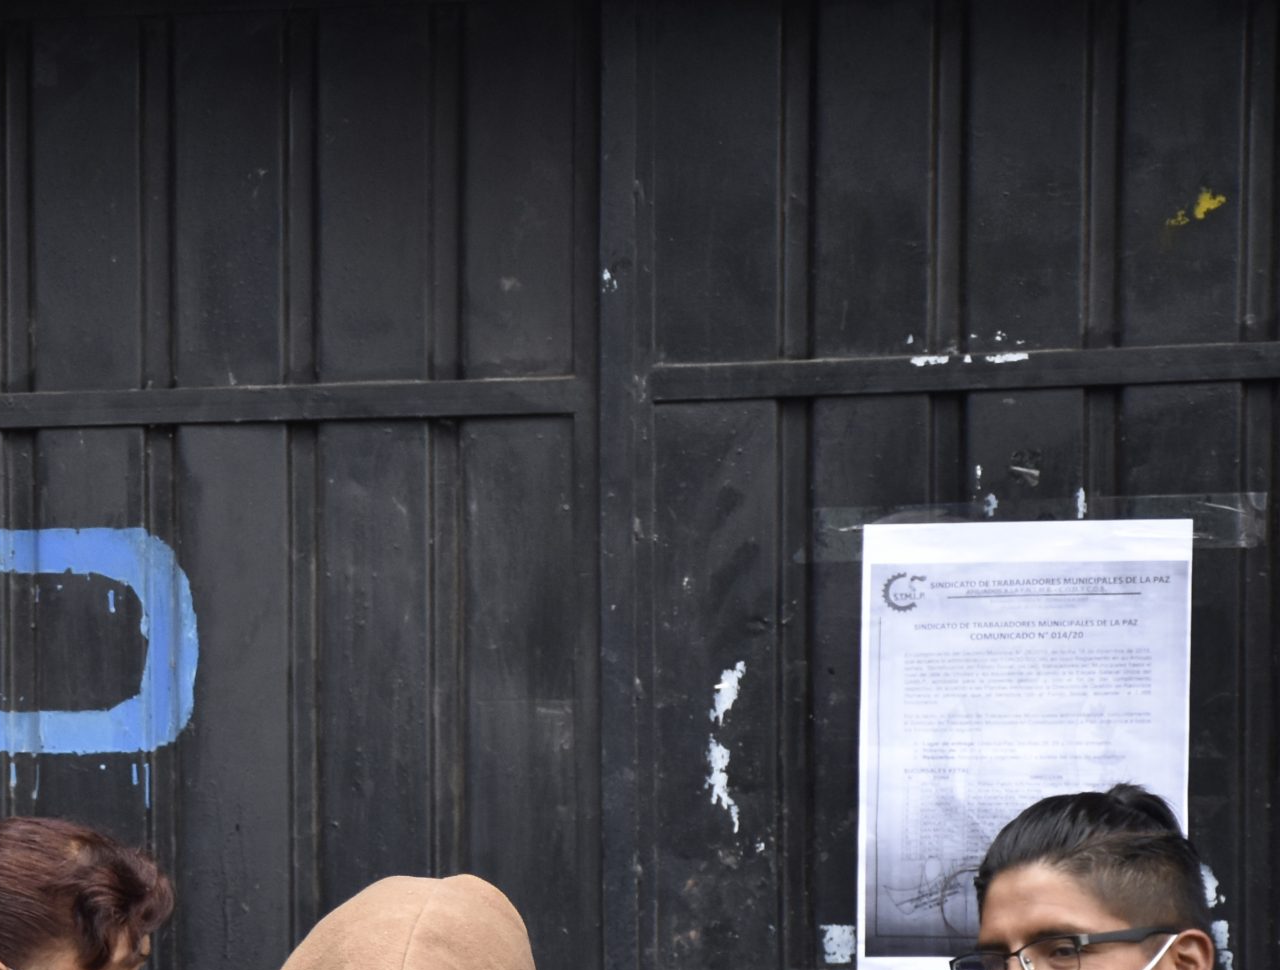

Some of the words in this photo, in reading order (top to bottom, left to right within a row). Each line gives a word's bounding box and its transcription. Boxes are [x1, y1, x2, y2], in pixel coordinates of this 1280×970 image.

[930, 581, 977, 589] SINDICATO
[979, 580, 989, 588] DE
[992, 578, 1061, 587] TRABAJADORES
[1063, 576, 1123, 585] MUNICIPALES
[1125, 576, 1138, 584] DE
[1139, 576, 1151, 584] LA
[1153, 575, 1171, 584] PAZ
[914, 622, 957, 631] SINDICATO
[973, 620, 1036, 628] TRABAJADORES
[1038, 619, 1094, 627] MUNICIPALES
[1122, 618, 1138, 626] PAZ
[970, 632, 1036, 640] COMUNICADO
[1050, 631, 1084, 640] 014/20
